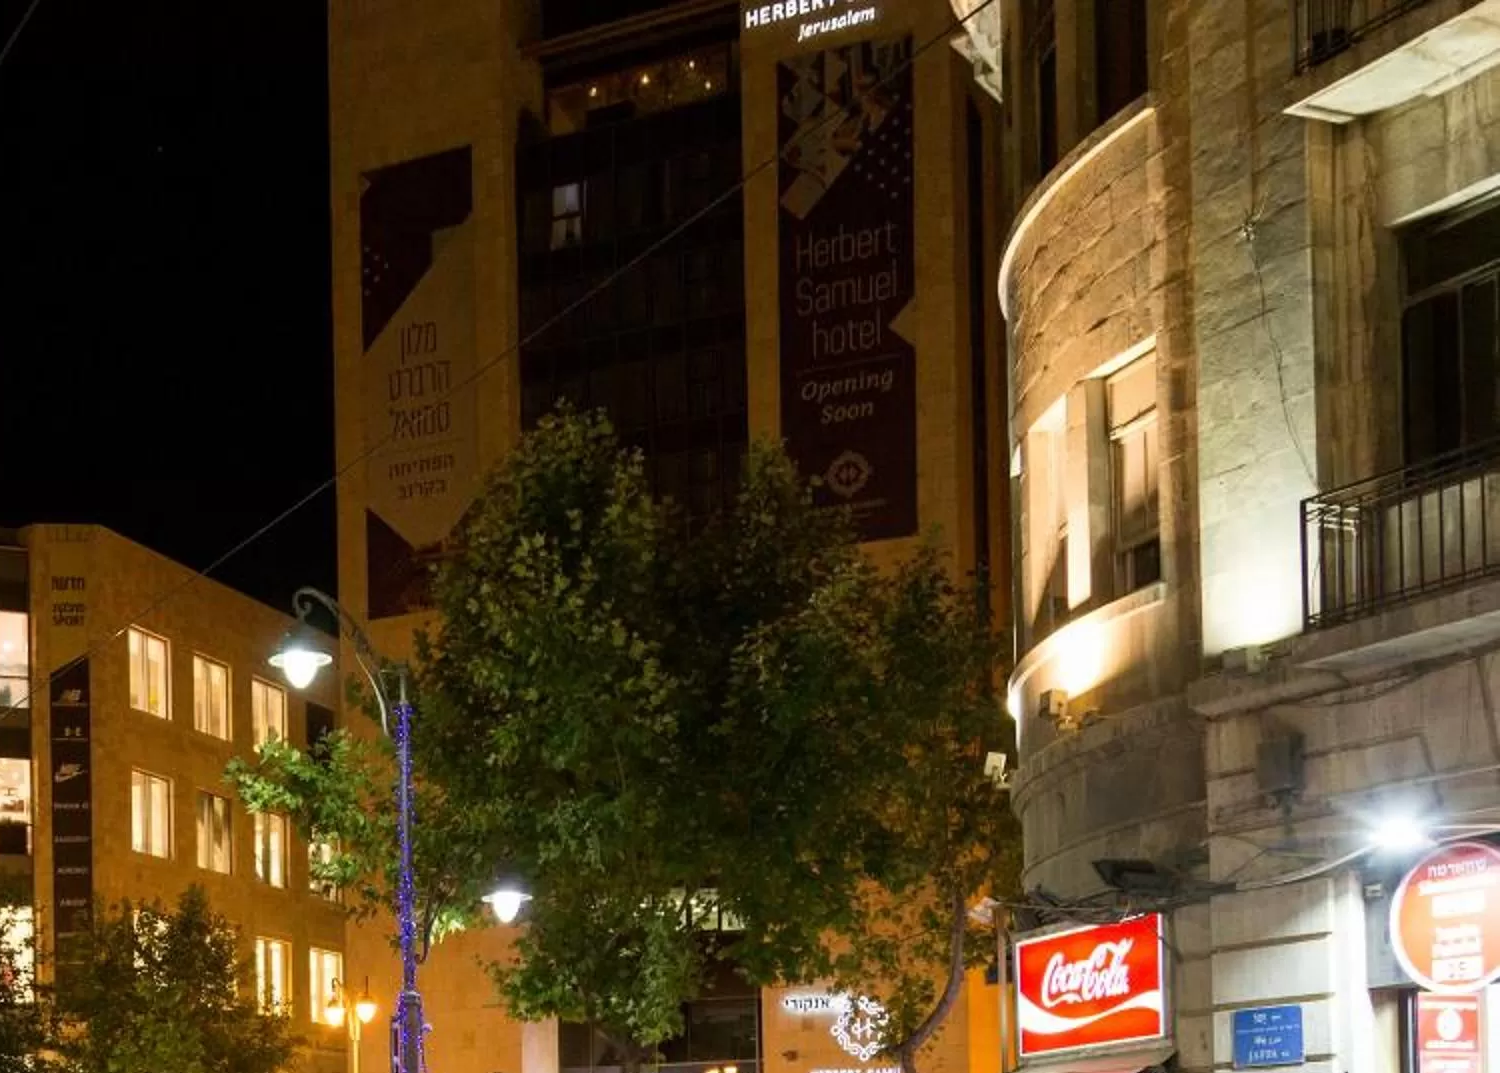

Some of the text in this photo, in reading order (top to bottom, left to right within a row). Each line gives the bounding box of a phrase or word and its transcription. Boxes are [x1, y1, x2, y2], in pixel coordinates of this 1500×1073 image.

[798, 7, 875, 42] Jerusalem
[795, 220, 899, 273] Herbert
[795, 257, 899, 317] Samuel
[400, 321, 438, 365] מלון
[812, 307, 882, 359] hotel
[388, 360, 450, 401] הרברט
[801, 368, 894, 404] Opening
[388, 402, 451, 442] סמואל
